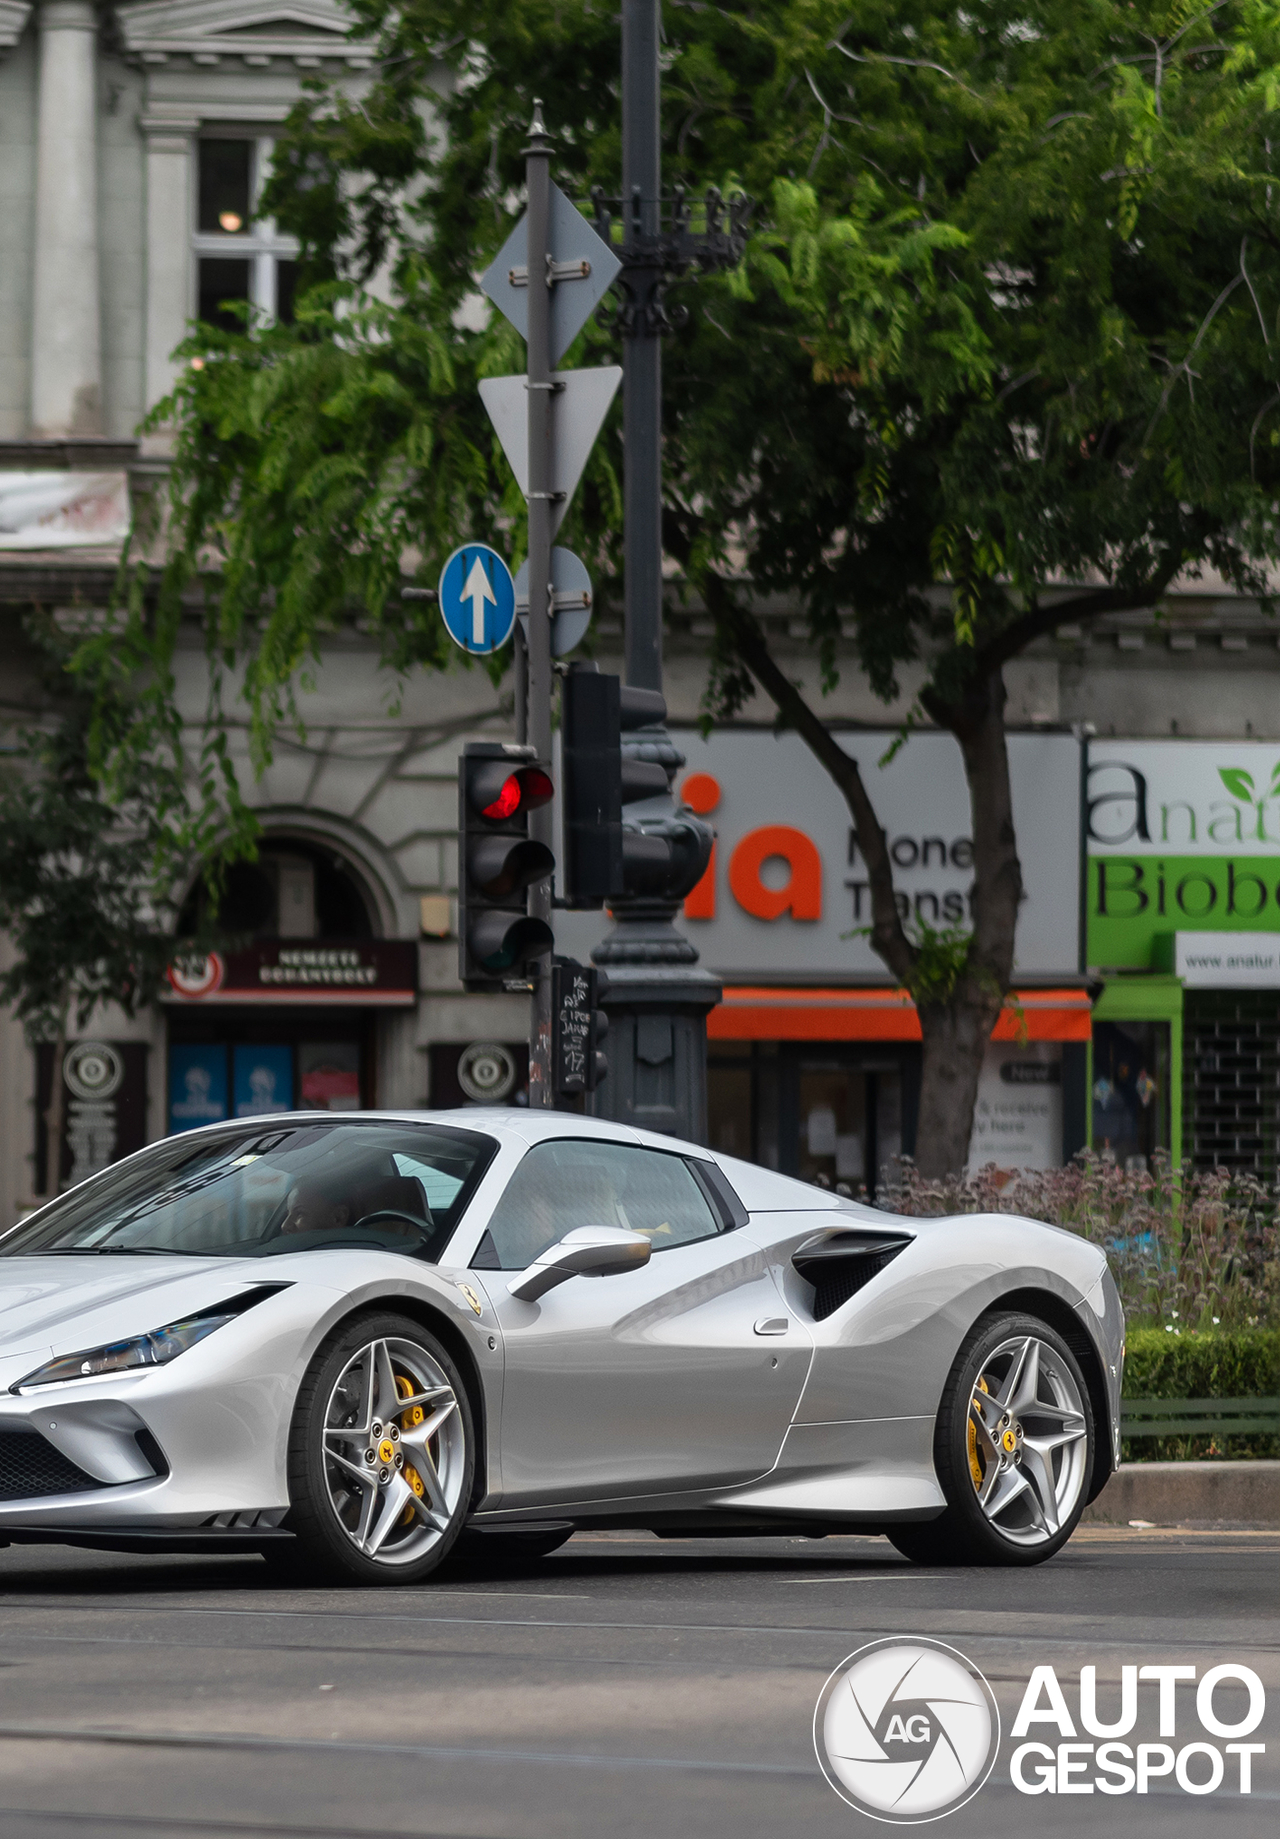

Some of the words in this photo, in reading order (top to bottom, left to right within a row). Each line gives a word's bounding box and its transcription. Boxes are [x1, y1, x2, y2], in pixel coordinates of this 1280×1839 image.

[1086, 759, 1280, 846] anat
[607, 772, 823, 921] ia
[1096, 860, 1280, 919] Biob
